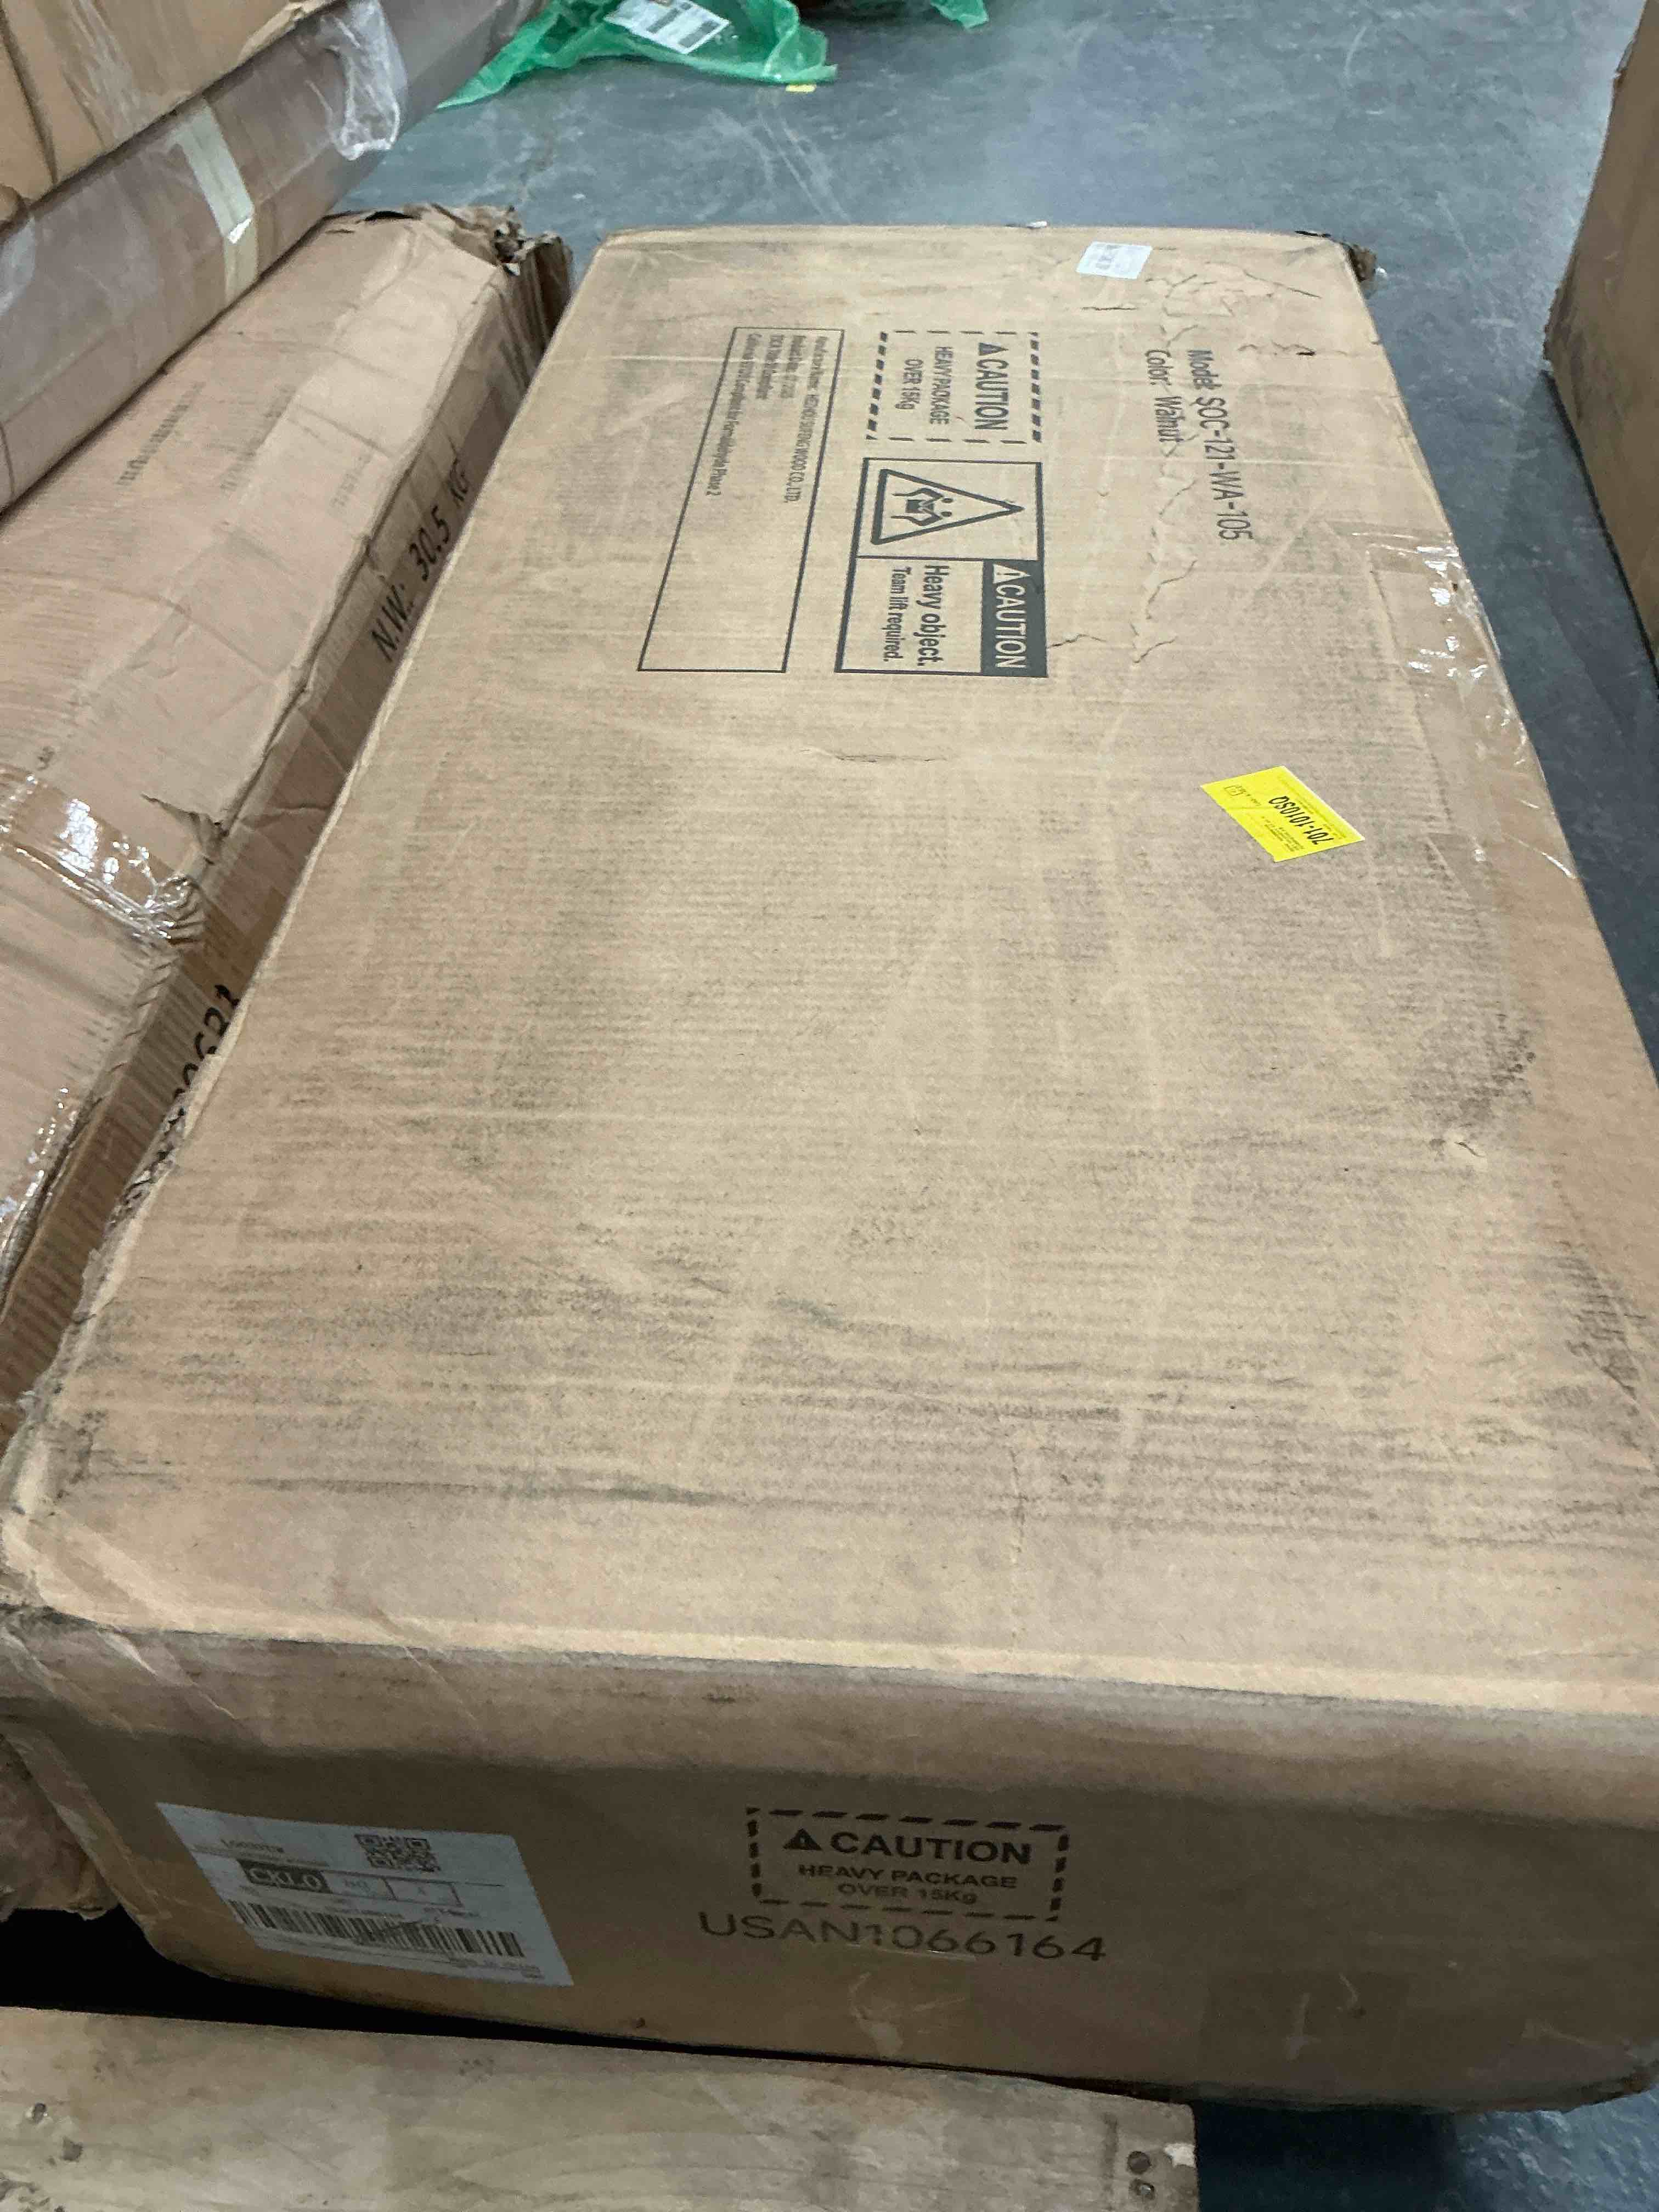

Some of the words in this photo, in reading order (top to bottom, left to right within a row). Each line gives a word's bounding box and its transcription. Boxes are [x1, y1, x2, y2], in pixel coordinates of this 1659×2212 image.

[902, 359, 924, 384] OVER
[933, 346, 953, 377] HEAVY
[895, 387, 921, 409] 15Kg
[930, 379, 952, 425] PACKAGE
[974, 359, 1009, 430] CAUTION
[1154, 396, 1185, 443] Walnut
[1196, 397, 1254, 541] SOC-121-WA-105
[409, 505, 450, 581] 30.5
[890, 566, 912, 594] Team
[916, 565, 950, 610] Heavy
[888, 596, 909, 610] lift
[880, 612, 905, 662] required.
[913, 613, 947, 667] object.
[995, 584, 1028, 668] CAUTION
[830, 1831, 1032, 1865] CAUTION
[798, 1864, 885, 1881] HEAVY
[891, 1869, 1018, 1889] PACKAGE
[837, 1883, 909, 1899] OVER
[918, 1887, 978, 1905] 15Kg
[698, 1911, 1107, 1962] USAN1066164
